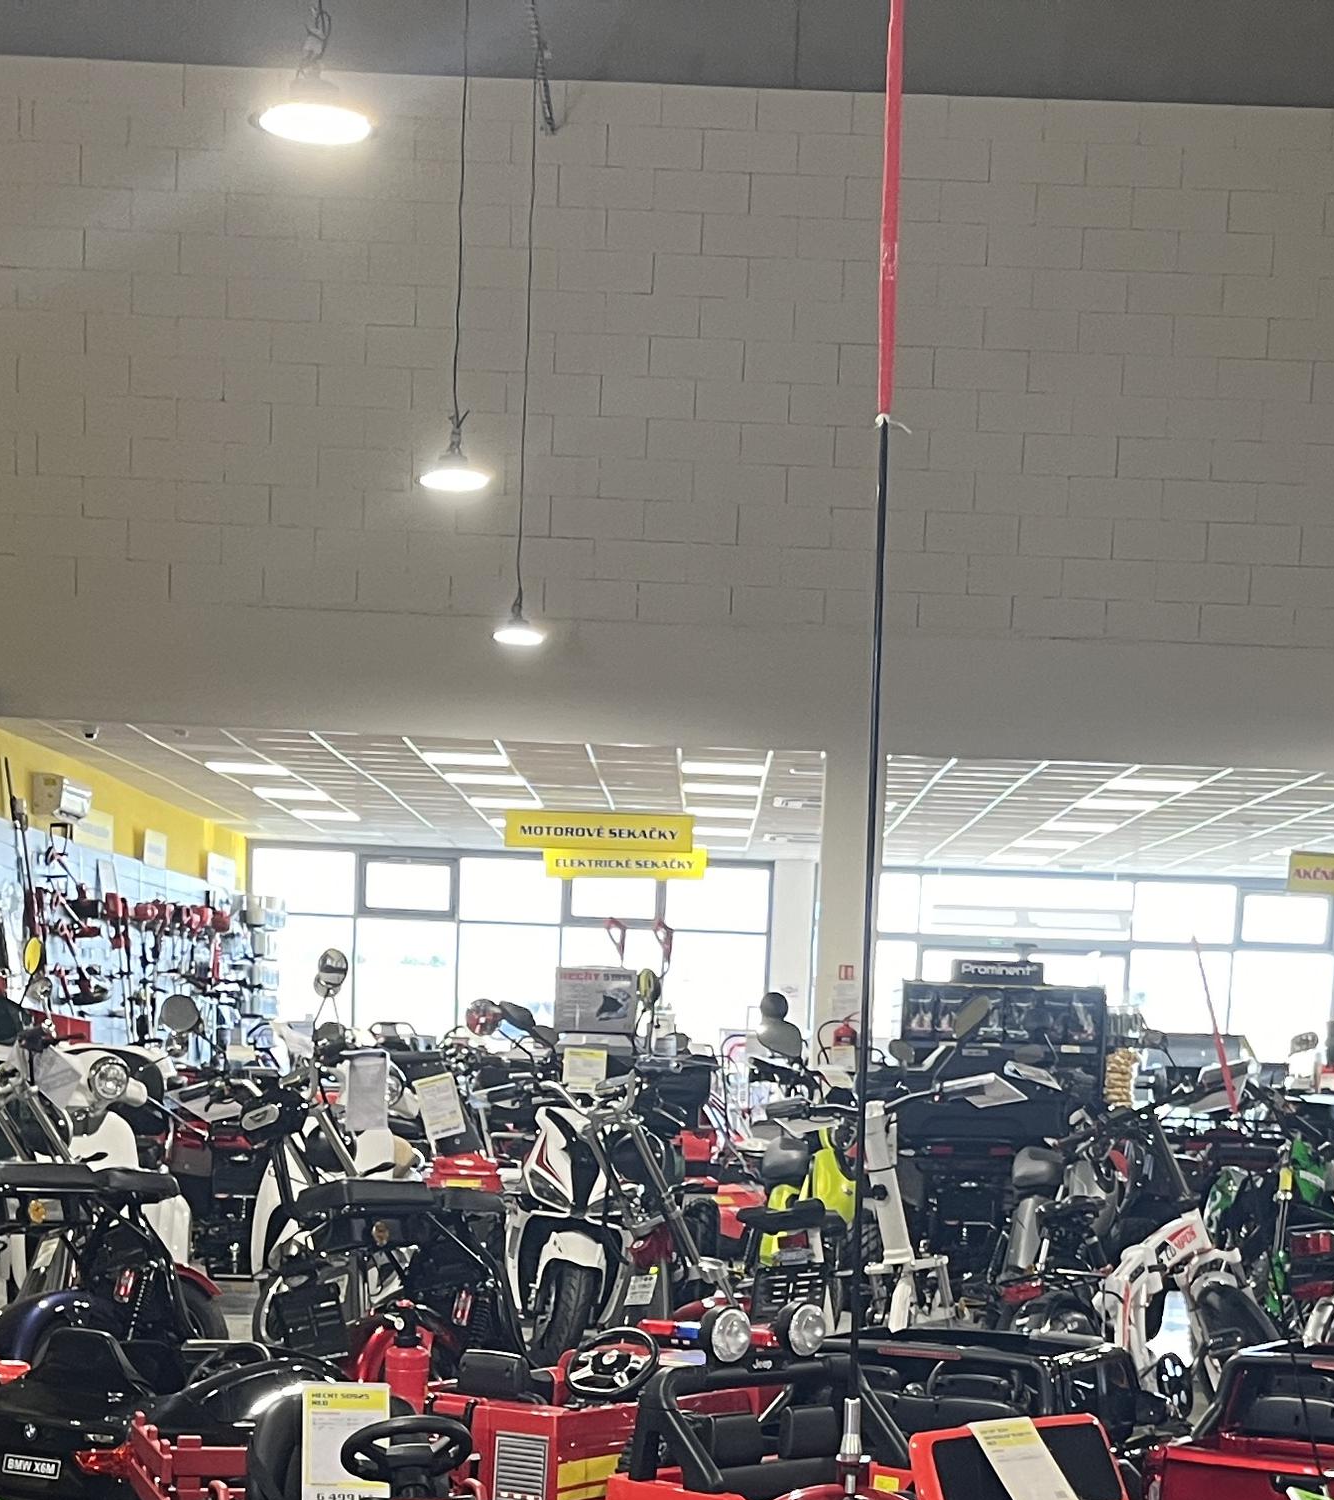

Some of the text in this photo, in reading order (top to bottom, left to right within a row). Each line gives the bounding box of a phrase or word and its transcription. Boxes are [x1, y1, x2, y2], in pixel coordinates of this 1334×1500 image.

[520, 825, 679, 840] MOTOROVÉ SEKAČKY
[555, 858, 694, 869] ELEKTRICKÉ SEKAČKY
[7, 1458, 56, 1475] BMW X6M
